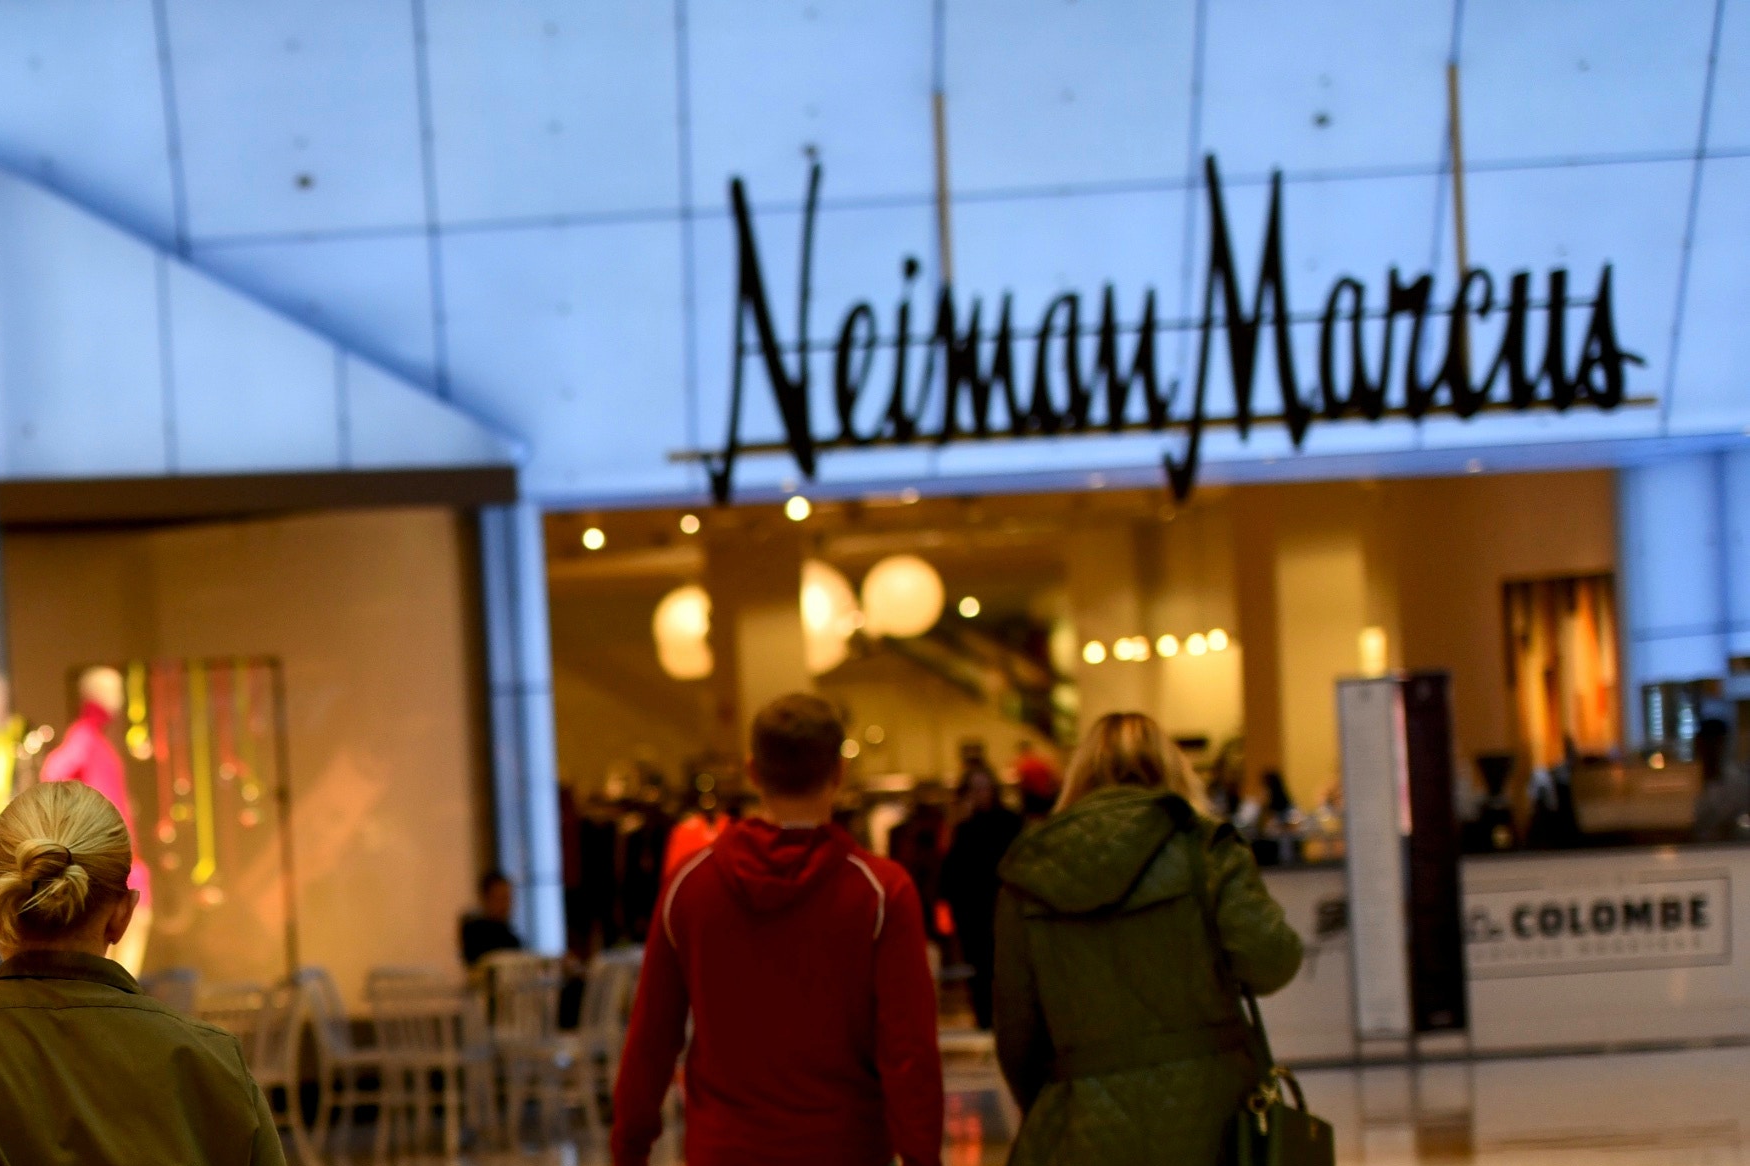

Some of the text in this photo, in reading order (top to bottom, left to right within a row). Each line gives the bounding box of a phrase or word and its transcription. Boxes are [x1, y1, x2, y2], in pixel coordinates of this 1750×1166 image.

[702, 152, 1646, 506] Neiman Marcus
[1510, 893, 1711, 941] COLOMBE
